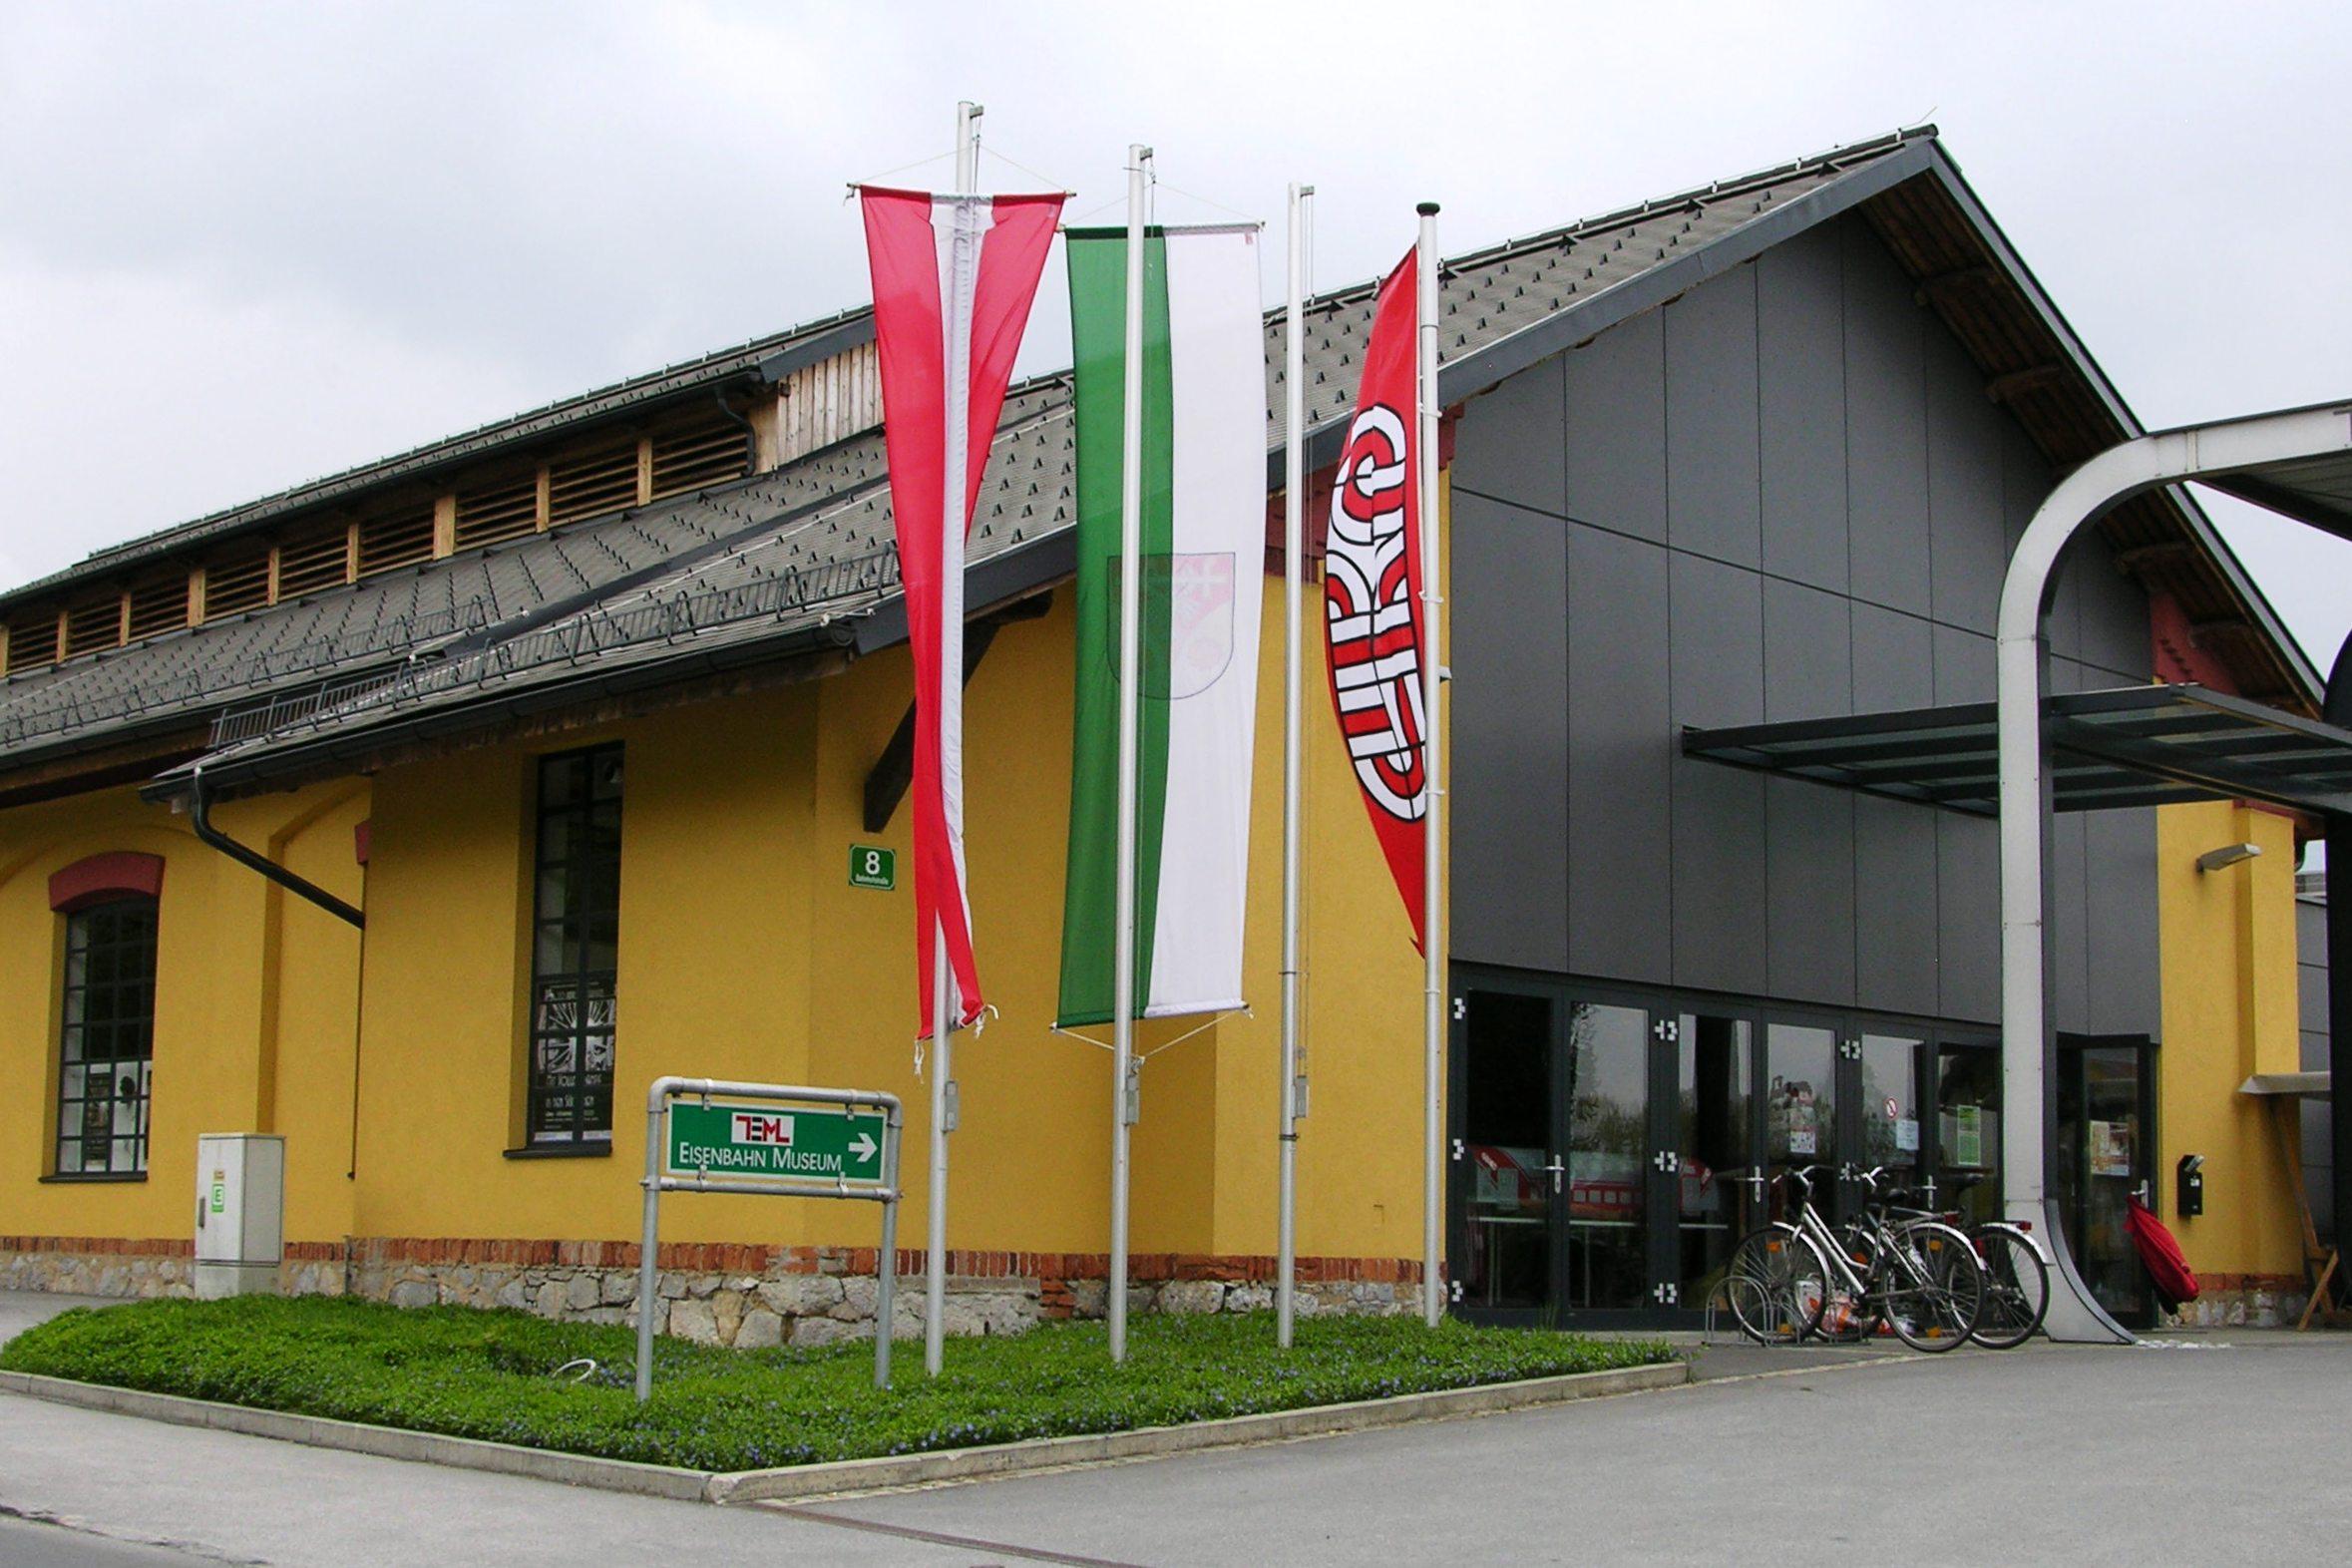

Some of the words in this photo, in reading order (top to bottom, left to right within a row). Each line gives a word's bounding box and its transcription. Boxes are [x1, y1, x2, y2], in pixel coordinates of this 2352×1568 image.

[865, 851, 880, 875] 8
[679, 1142, 766, 1168] EISENBAHN
[773, 1148, 842, 1172] MUSEUM
